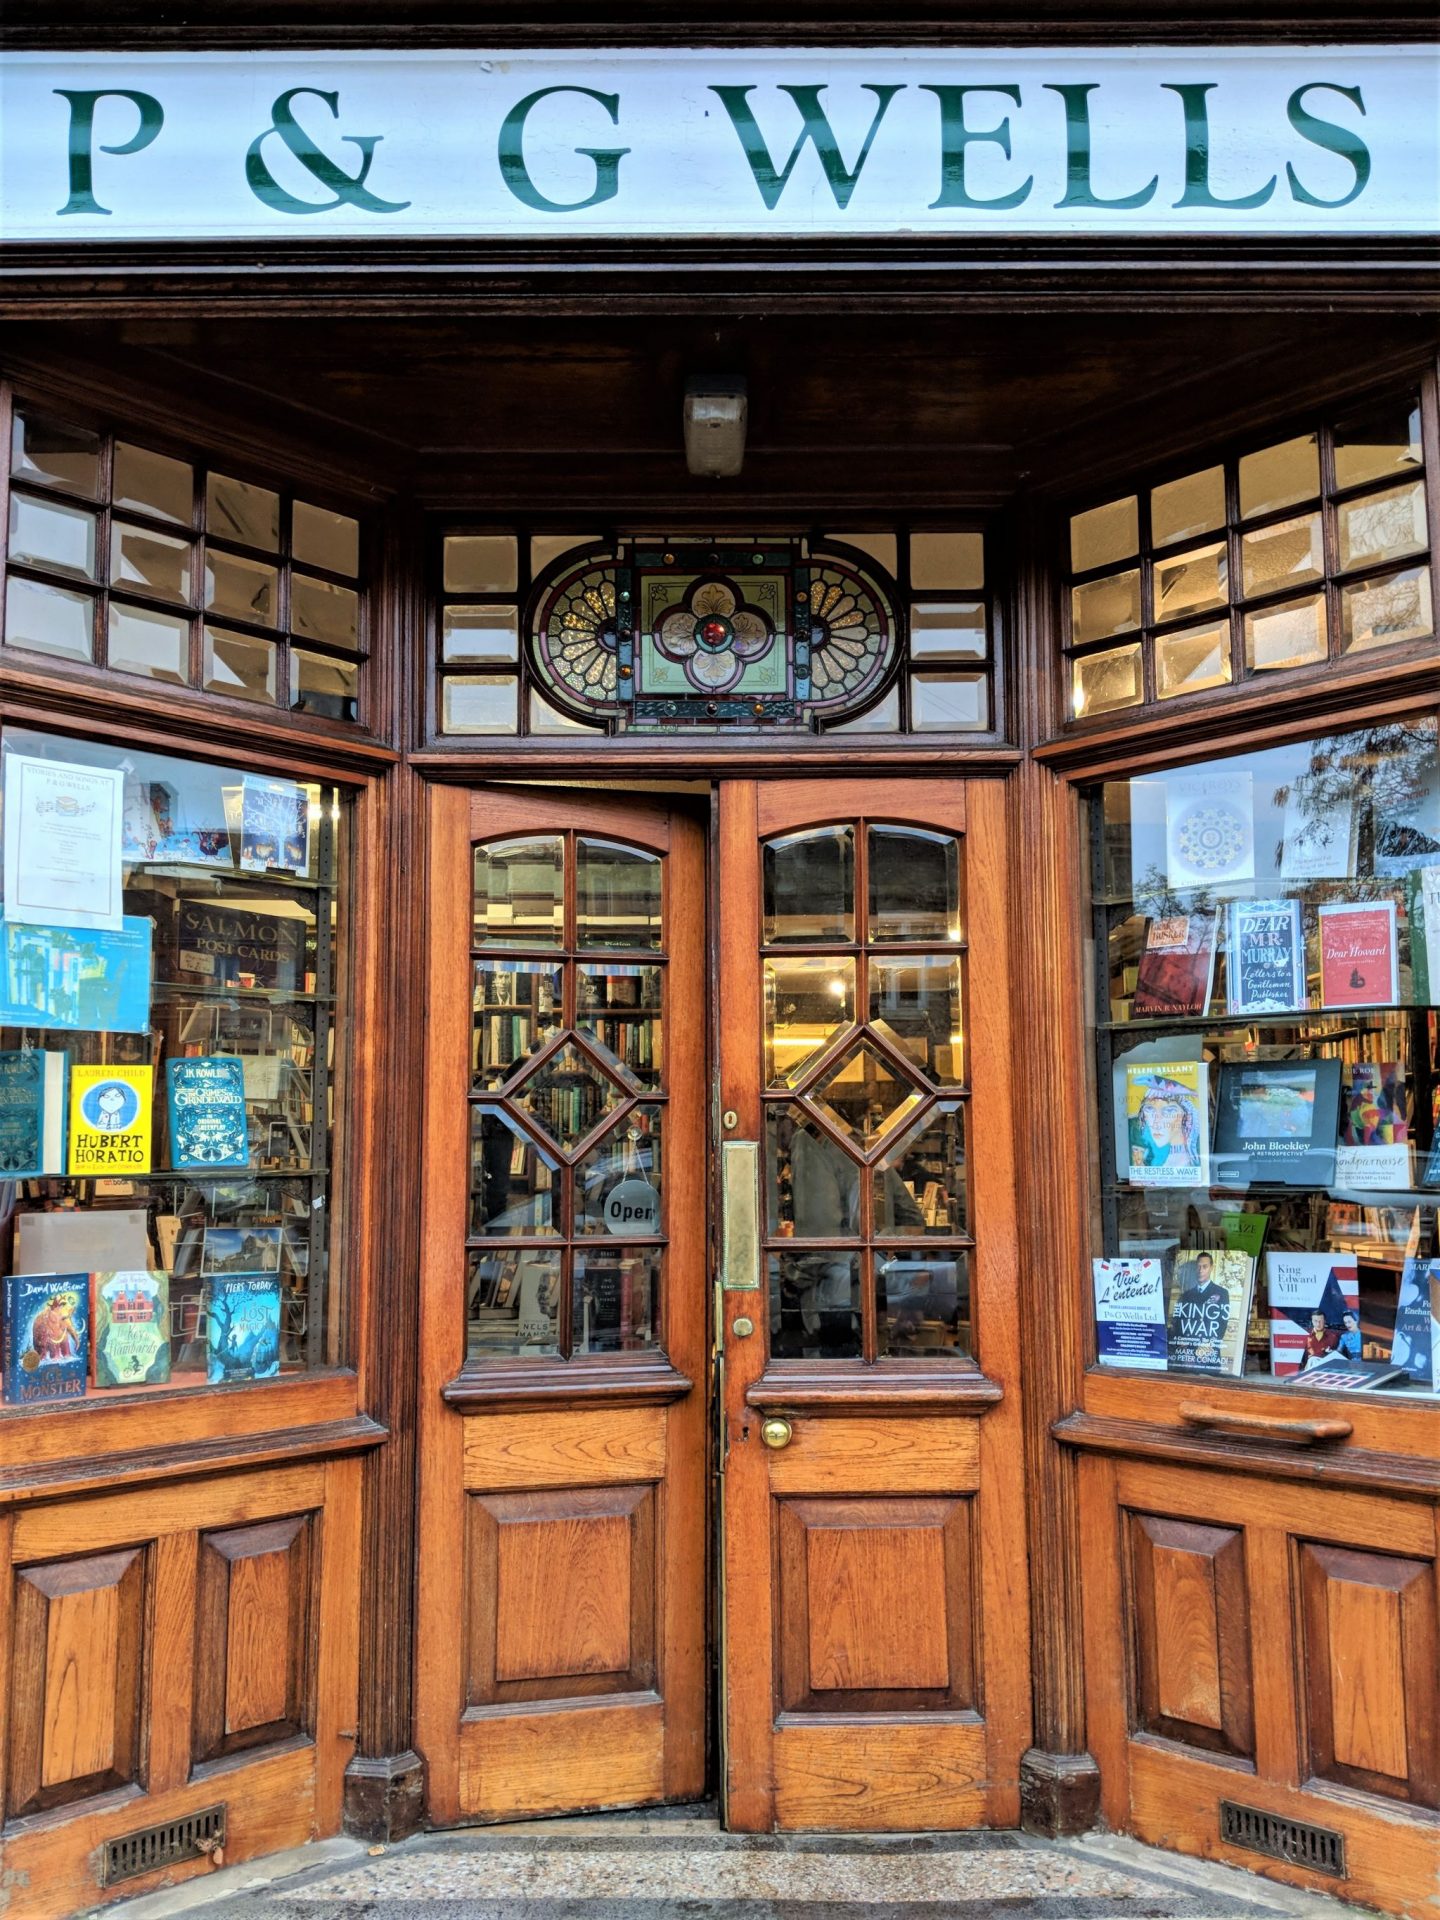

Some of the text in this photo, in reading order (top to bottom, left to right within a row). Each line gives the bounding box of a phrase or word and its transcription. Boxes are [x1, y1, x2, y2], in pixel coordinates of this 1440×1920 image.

[52, 82, 1371, 215] P & G WELLS
[186, 912, 299, 946] SALMON
[1242, 916, 1290, 933] DEAR
[197, 937, 290, 964] POST CARDS
[1241, 947, 1291, 964] MURRAY
[1326, 944, 1387, 960] Dear Howard
[1243, 967, 1275, 980] Letters
[1247, 979, 1292, 989] Gentleman
[1251, 989, 1288, 1001] Publisher
[196, 1068, 230, 1079] ROWLI
[1127, 1065, 1194, 1075] HELEN BELLANY
[76, 1134, 143, 1149] HUBERT
[1242, 1142, 1311, 1152] John Blockley
[75, 1150, 144, 1163] HORATIO
[1336, 1150, 1405, 1170] ontparnasse
[1130, 1167, 1142, 1175] THE
[1144, 1167, 1174, 1175] RESTLESS
[610, 1201, 656, 1222] Open
[1278, 1264, 1301, 1276] King
[1113, 1270, 1140, 1286] Vive
[1278, 1273, 1317, 1284] Edward
[19, 1281, 86, 1297] David Walliams
[225, 1280, 273, 1293] PIERS TORDAY
[1098, 1276, 1160, 1304] L'entente!
[1278, 1283, 1298, 1292] VIII
[240, 1305, 273, 1323] LOST
[1104, 1311, 1158, 1321] P&G Wells Ltd
[1180, 1303, 1231, 1320] KING'S
[1405, 1307, 1431, 1316] Enchan
[1181, 1319, 1219, 1337] WAR
[1197, 1356, 1228, 1365] CONRADI
[20, 1379, 82, 1399] MONSTER
